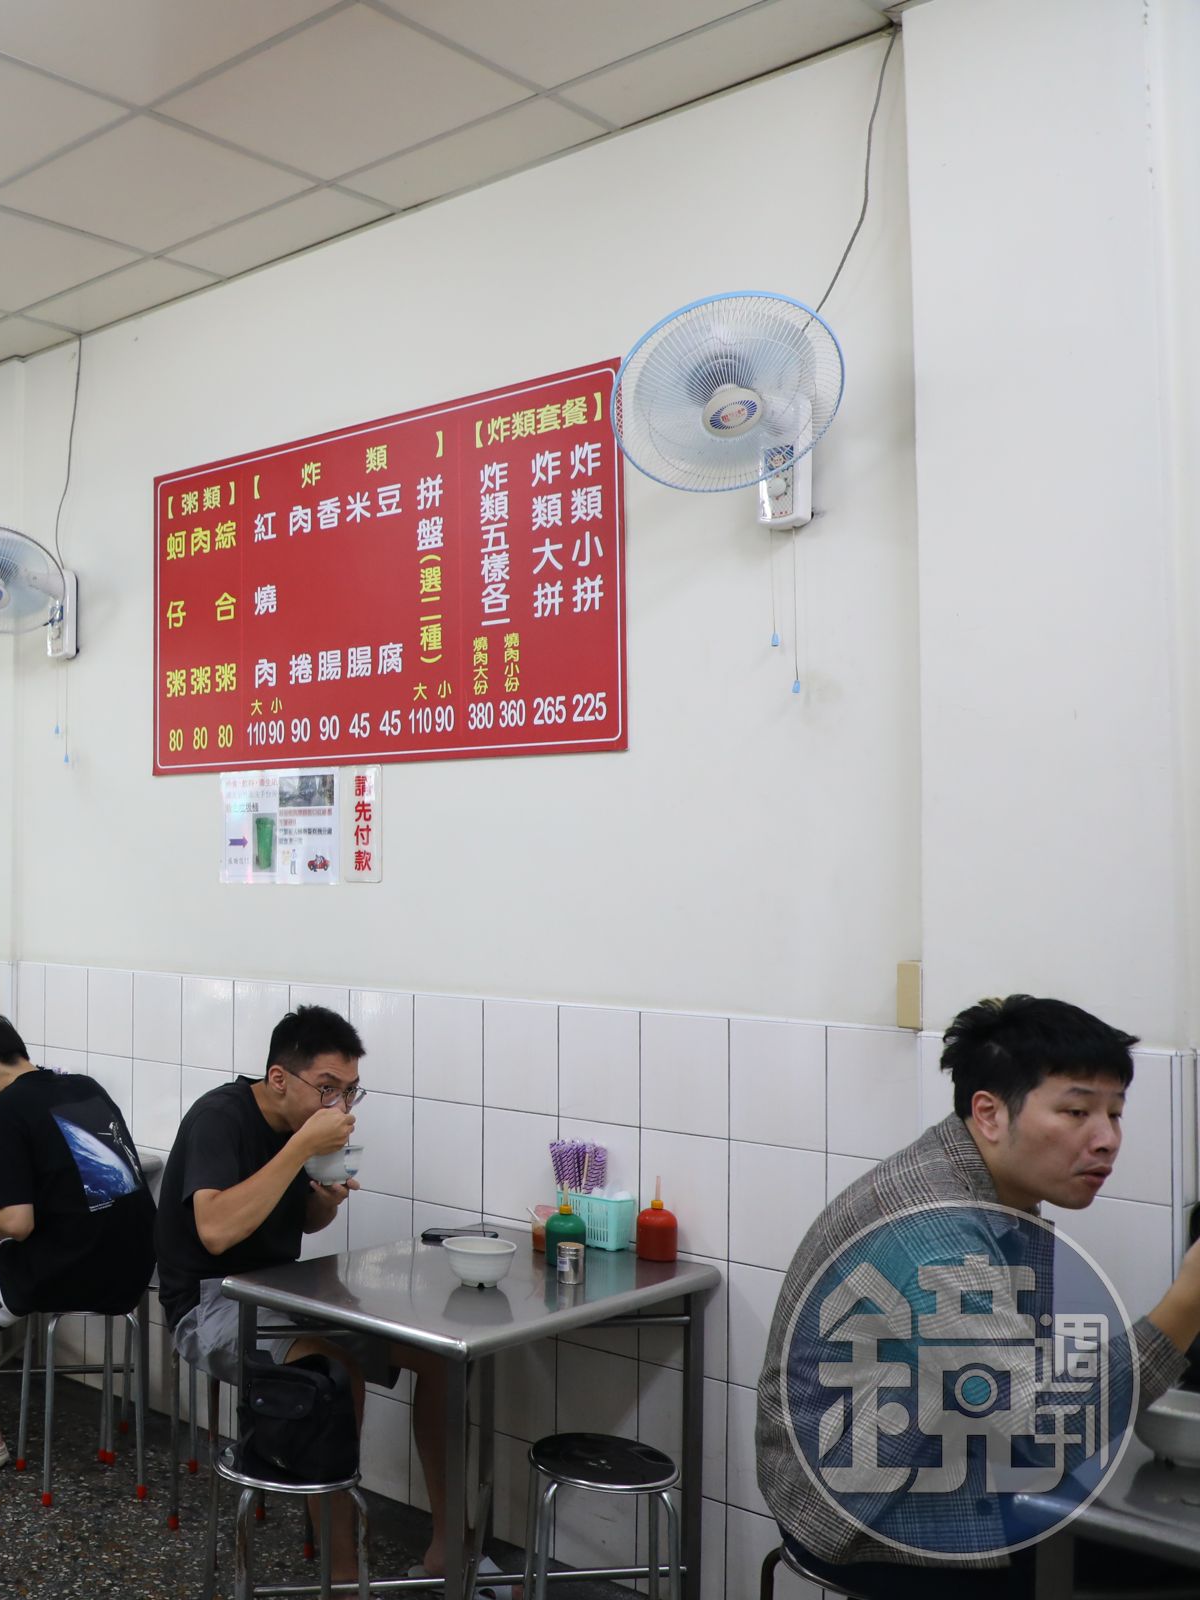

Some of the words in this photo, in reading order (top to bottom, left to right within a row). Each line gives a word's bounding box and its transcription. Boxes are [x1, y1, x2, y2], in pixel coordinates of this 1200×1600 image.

[413, 682, 428, 701] 大
[437, 680, 452, 699] 小
[251, 699, 263, 716] 大
[270, 697, 282, 714] 小
[169, 728, 183, 752] 80
[193, 726, 208, 750] 80
[218, 724, 233, 748] 80
[247, 721, 267, 746] 110
[268, 719, 285, 744] 90
[291, 717, 311, 743] 90
[319, 715, 340, 740] 90
[349, 712, 371, 738] 45
[380, 710, 402, 736] 45
[408, 707, 432, 734] 110
[435, 705, 455, 733] 90
[468, 702, 494, 730] 380
[499, 699, 526, 728] 360
[533, 695, 566, 726] 265
[572, 692, 607, 723] 225
